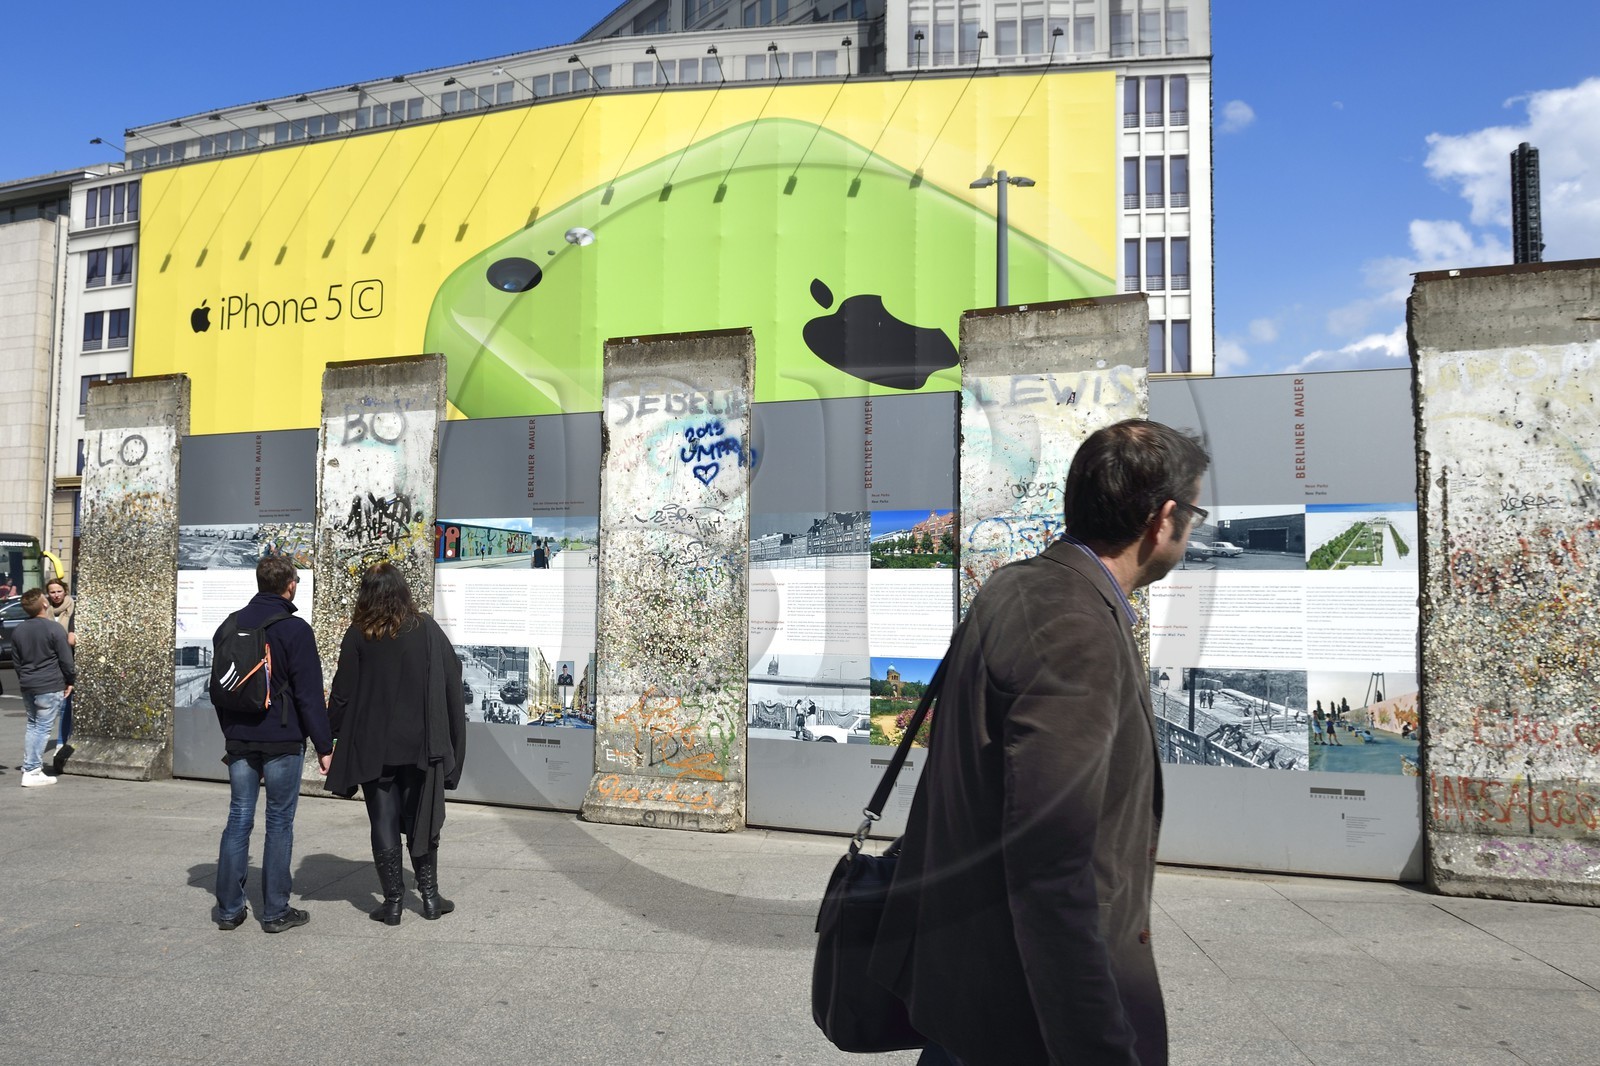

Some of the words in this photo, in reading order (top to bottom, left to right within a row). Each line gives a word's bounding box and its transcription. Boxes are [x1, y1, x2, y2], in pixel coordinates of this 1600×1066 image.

[220, 292, 318, 330] iPhone
[325, 284, 343, 320] 5
[971, 364, 1136, 410] LEWIS
[1294, 378, 1304, 417] MAUER
[528, 419, 536, 450] MAUER
[864, 400, 873, 435] MAUER
[97, 431, 149, 467] LO
[864, 440, 873, 489] BERLINER
[1295, 423, 1306, 479] BERLINER
[254, 466, 262, 506] BERLINER
[527, 454, 536, 498] BERLINER
